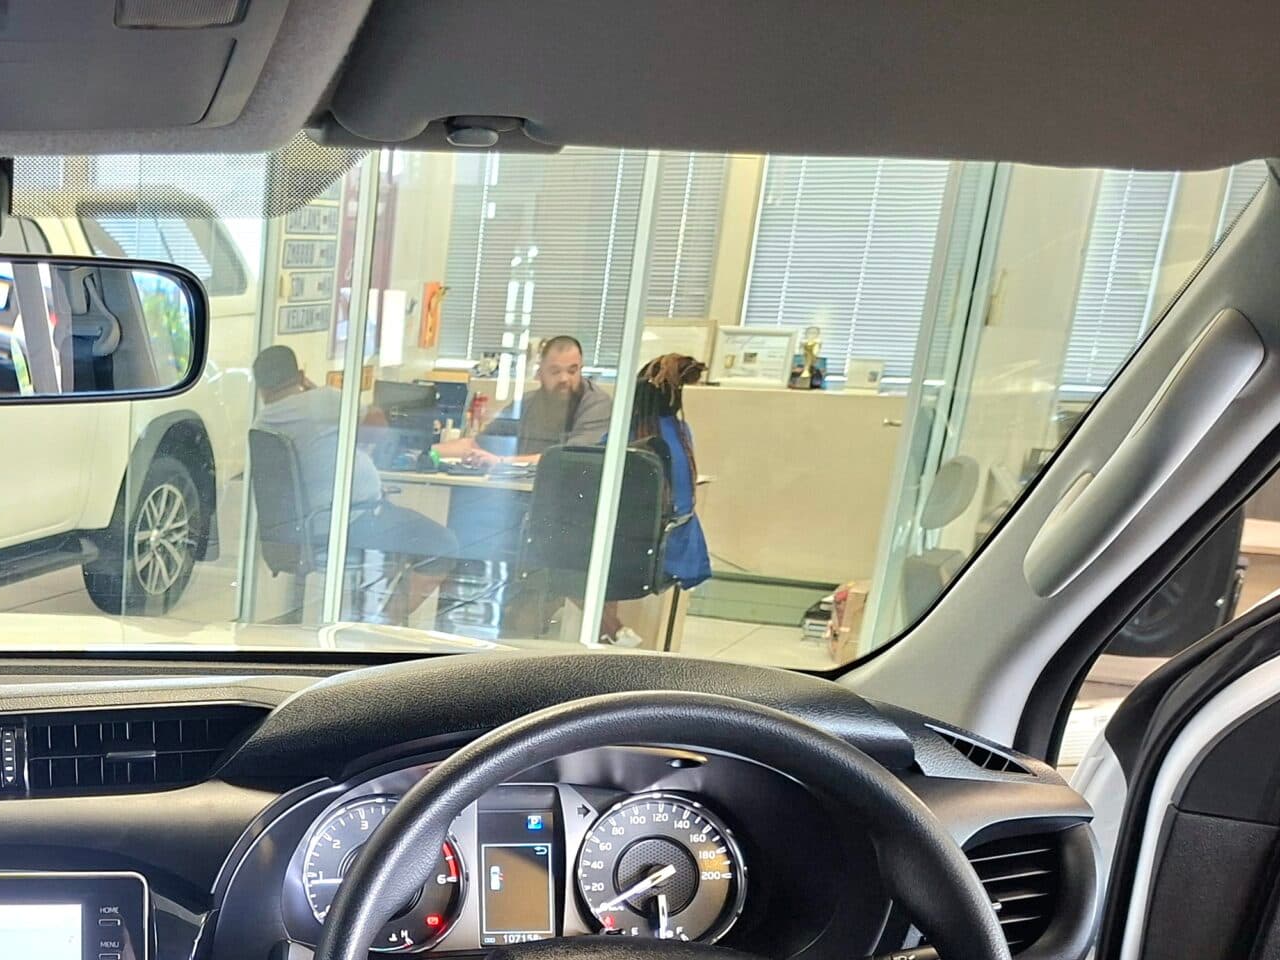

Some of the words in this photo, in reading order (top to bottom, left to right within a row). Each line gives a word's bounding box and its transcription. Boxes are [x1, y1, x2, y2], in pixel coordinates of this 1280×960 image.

[629, 815, 646, 824] 100
[652, 813, 669, 822] 120
[361, 822, 369, 830] 3
[673, 819, 690, 829] 140
[612, 826, 625, 835] 80
[689, 833, 707, 843] 160
[332, 839, 341, 848] 2
[599, 842, 612, 851] 60
[698, 850, 715, 859] 180
[590, 860, 604, 869] 40
[436, 874, 446, 884] 6
[701, 871, 721, 880] 200
[591, 882, 605, 891] 20
